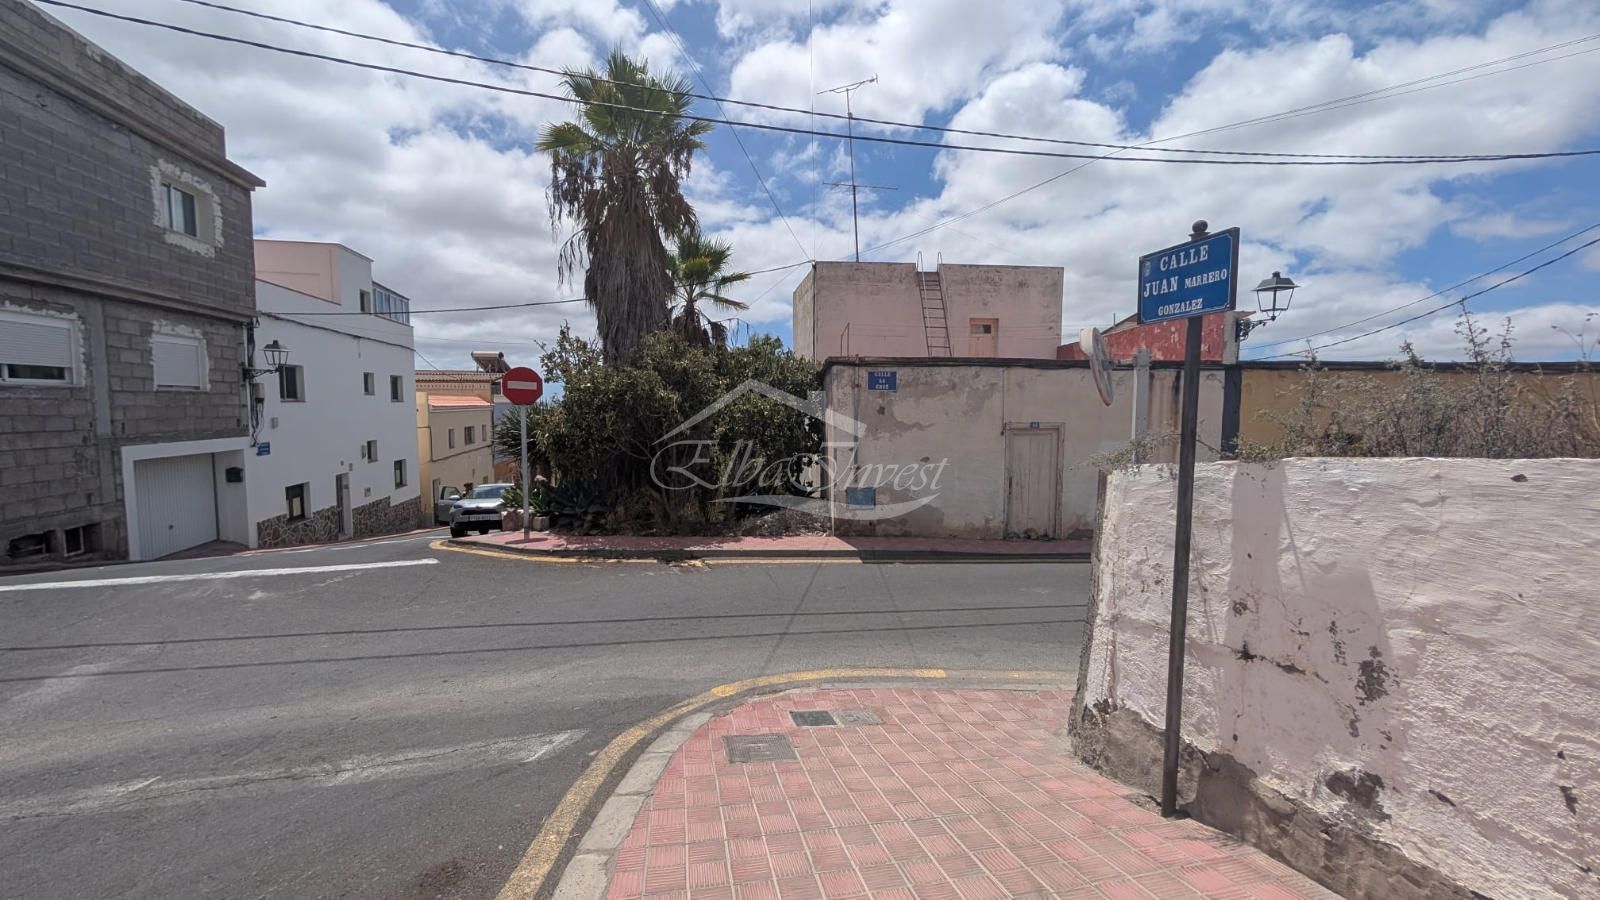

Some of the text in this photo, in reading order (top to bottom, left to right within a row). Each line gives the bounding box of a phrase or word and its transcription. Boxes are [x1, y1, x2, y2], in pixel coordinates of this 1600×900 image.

[1160, 245, 1208, 271] CALLE
[1143, 268, 1228, 298] JUAN MARRERO
[1158, 298, 1203, 316] GONZALEZ
